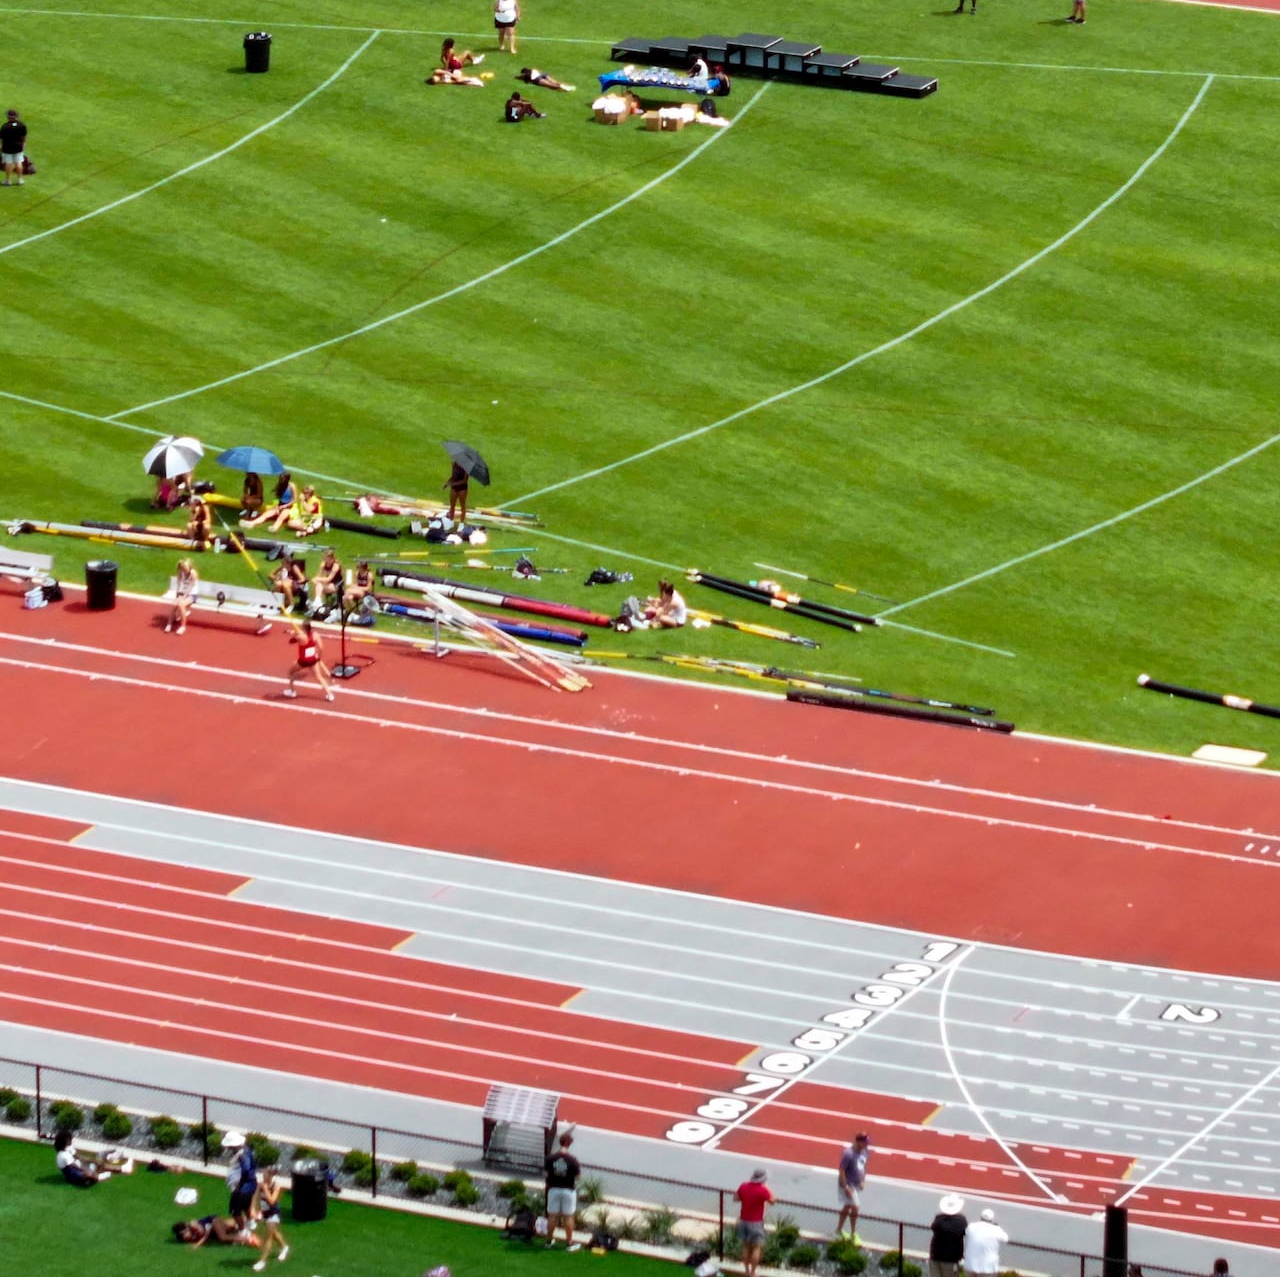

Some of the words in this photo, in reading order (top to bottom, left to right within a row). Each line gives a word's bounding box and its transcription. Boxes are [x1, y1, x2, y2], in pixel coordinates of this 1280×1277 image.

[922, 941, 959, 963] 1
[881, 961, 934, 986] 2
[852, 984, 905, 1007] 3
[821, 1006, 876, 1030] 4
[1159, 1003, 1221, 1025] 2
[792, 1027, 846, 1052] 5
[760, 1051, 814, 1075] 6
[732, 1073, 786, 1098] 7
[696, 1097, 749, 1121] 8
[665, 1120, 717, 1145] 9
